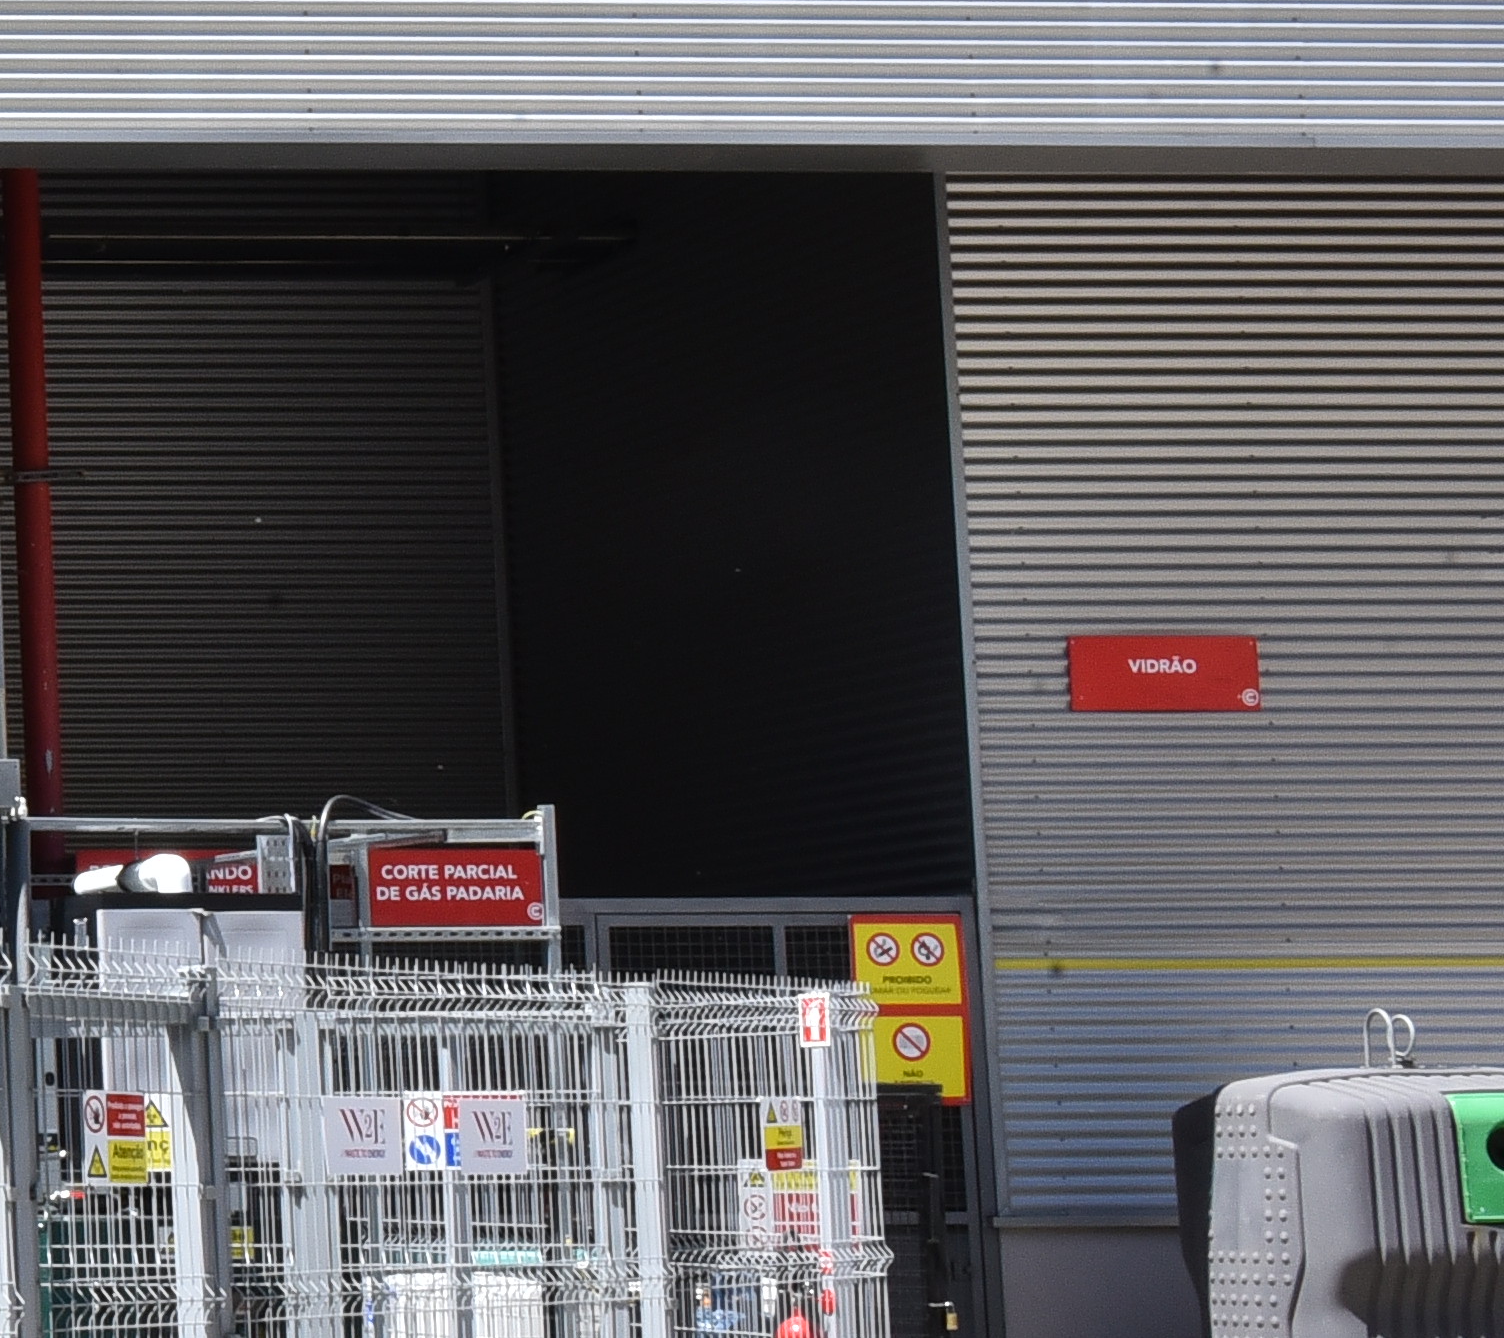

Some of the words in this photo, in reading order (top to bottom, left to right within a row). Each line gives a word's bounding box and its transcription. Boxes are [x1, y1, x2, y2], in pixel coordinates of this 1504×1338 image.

[1128, 655, 1197, 674] VIDRÃO
[381, 864, 439, 880] CORTE
[444, 864, 518, 880] PARCIAL
[376, 886, 401, 901] DE
[405, 882, 442, 901] GÁS
[446, 886, 525, 901] PADARIA
[882, 975, 933, 984] PROIBIDO
[903, 1069, 924, 1078] NÃO
